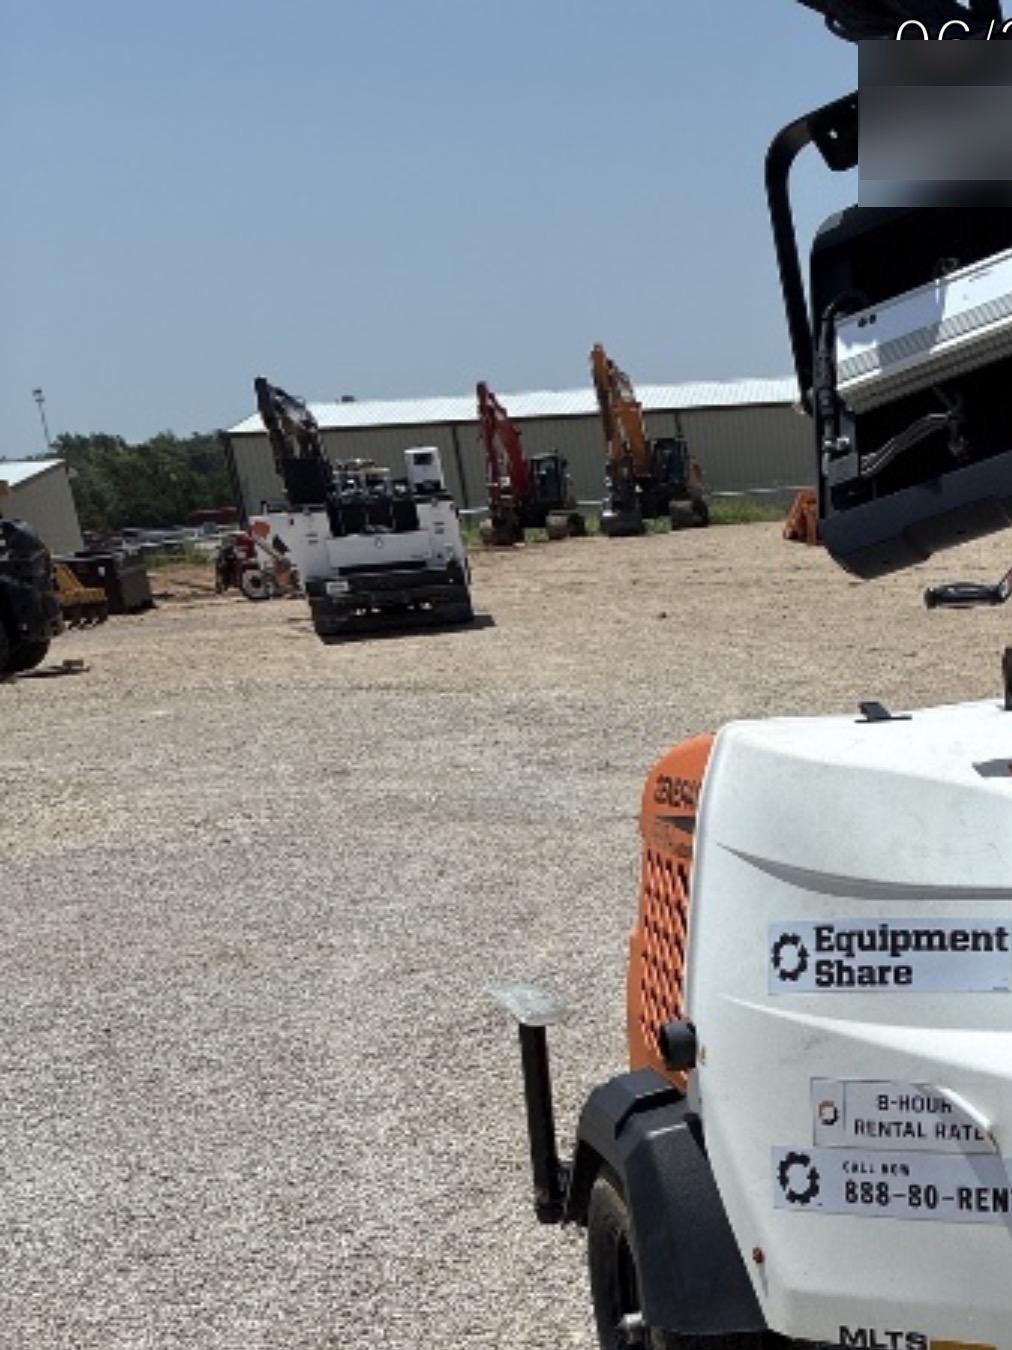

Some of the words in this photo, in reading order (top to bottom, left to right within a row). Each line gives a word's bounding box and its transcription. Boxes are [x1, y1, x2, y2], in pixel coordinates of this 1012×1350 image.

[814, 923, 1009, 958] Equipment
[815, 959, 913, 988] Share
[853, 1119, 927, 1139] RENTAL
